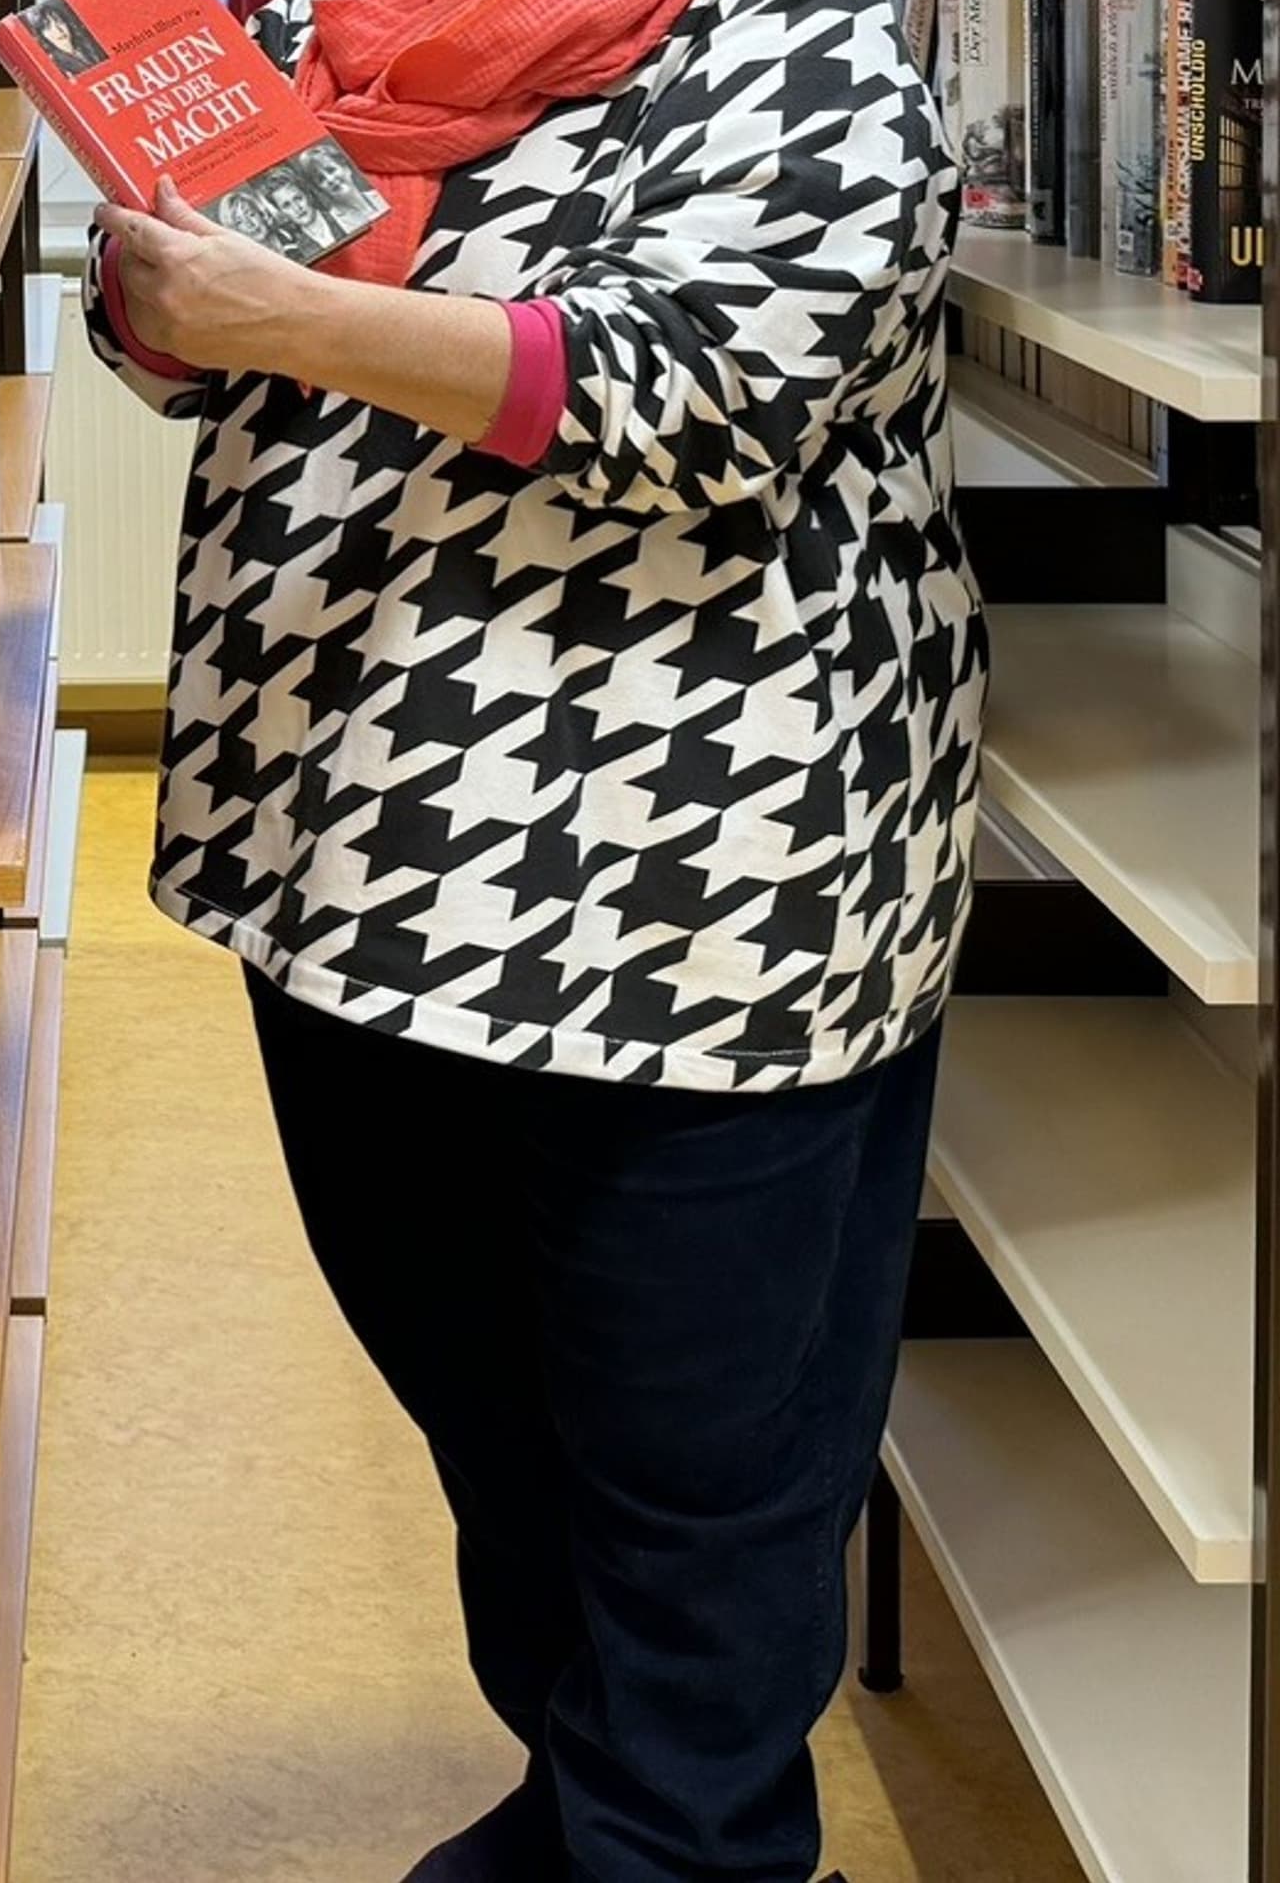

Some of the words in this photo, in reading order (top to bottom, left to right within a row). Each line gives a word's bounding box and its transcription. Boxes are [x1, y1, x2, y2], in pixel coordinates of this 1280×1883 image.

[87, 26, 227, 116] FRAUEN
[968, 29, 981, 63] Der
[134, 80, 263, 168] MACHT
[142, 94, 177, 125] AN
[169, 72, 222, 108] DER
